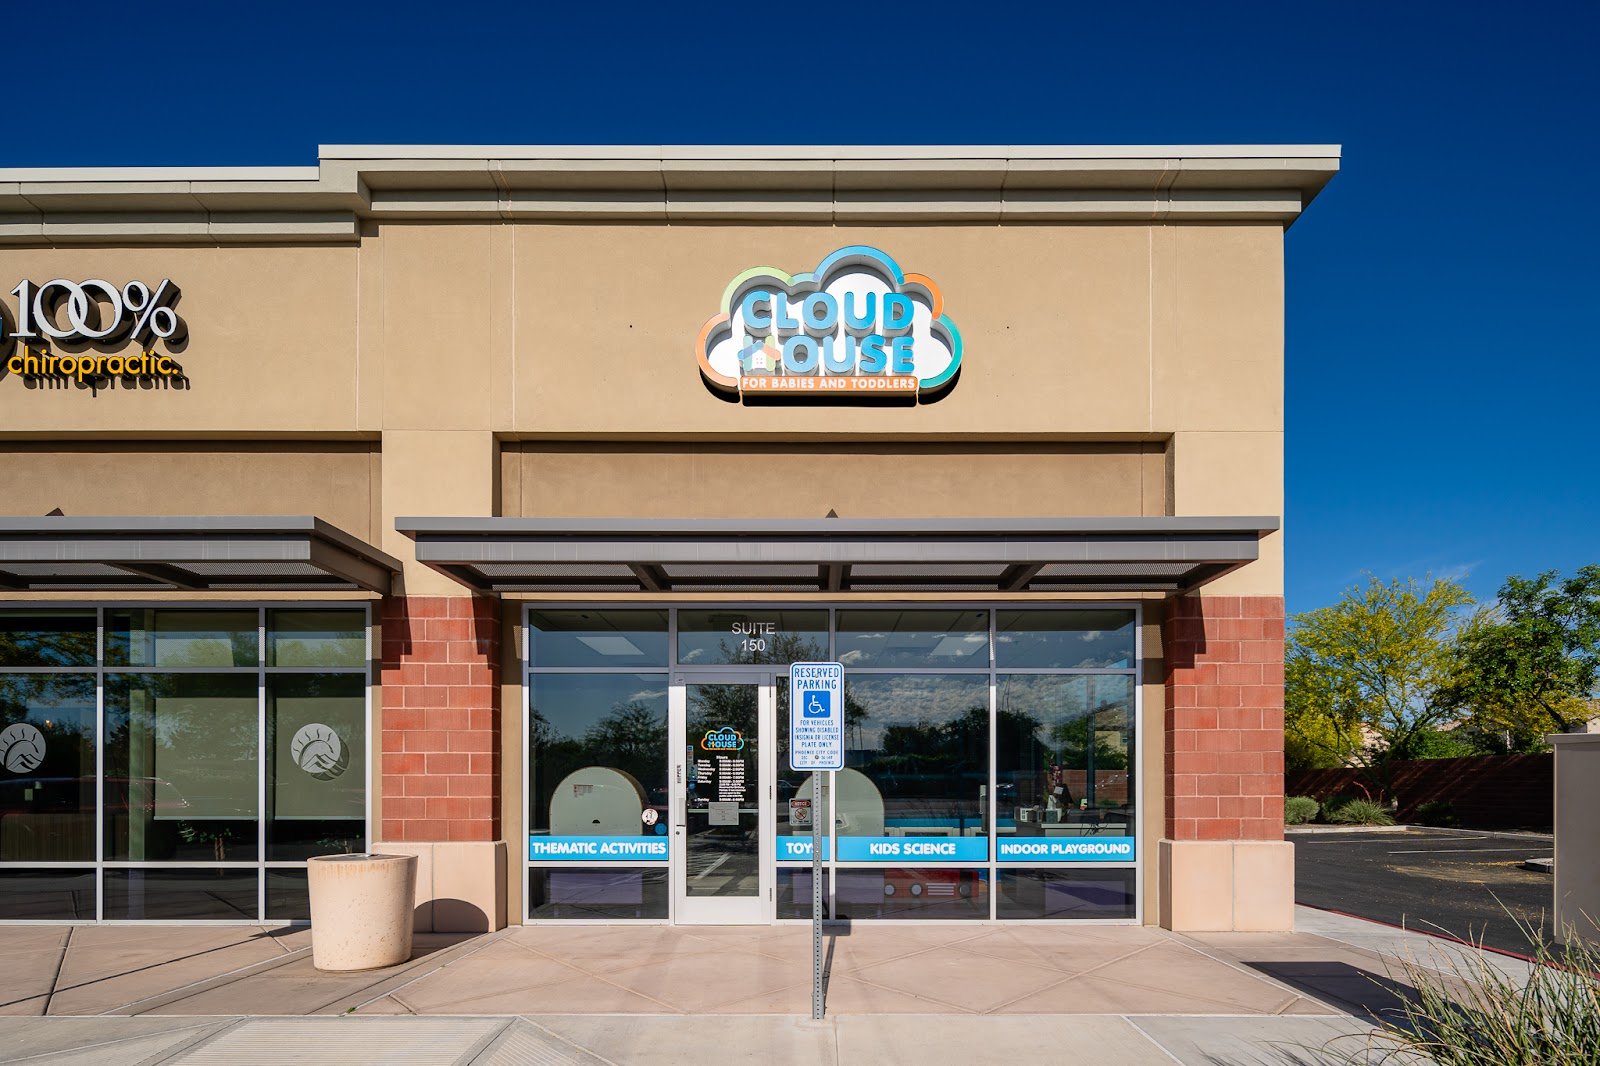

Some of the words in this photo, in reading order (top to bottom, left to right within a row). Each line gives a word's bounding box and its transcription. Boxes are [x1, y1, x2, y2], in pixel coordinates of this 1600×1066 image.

[9, 278, 177, 339] 100%
[741, 290, 915, 331] CLOUD
[7, 345, 179, 382] chiropractic.
[742, 378, 767, 389] FOR
[771, 378, 815, 389] BABIES
[819, 378, 847, 389] AND
[851, 378, 915, 389] TODDLERS
[731, 622, 776, 635] SUITE
[741, 639, 766, 652] 150
[794, 667, 839, 678] RESERVED
[797, 679, 837, 689] PARKING
[532, 842, 598, 855] THEMATIC
[599, 842, 667, 855] ACTIVITIES
[786, 842, 814, 855] TOY
[869, 843, 900, 855] KIDS
[903, 843, 956, 855] SCIENCE
[1000, 844, 1049, 855] INDOOR
[1051, 844, 1131, 855] PLAYGROUND
